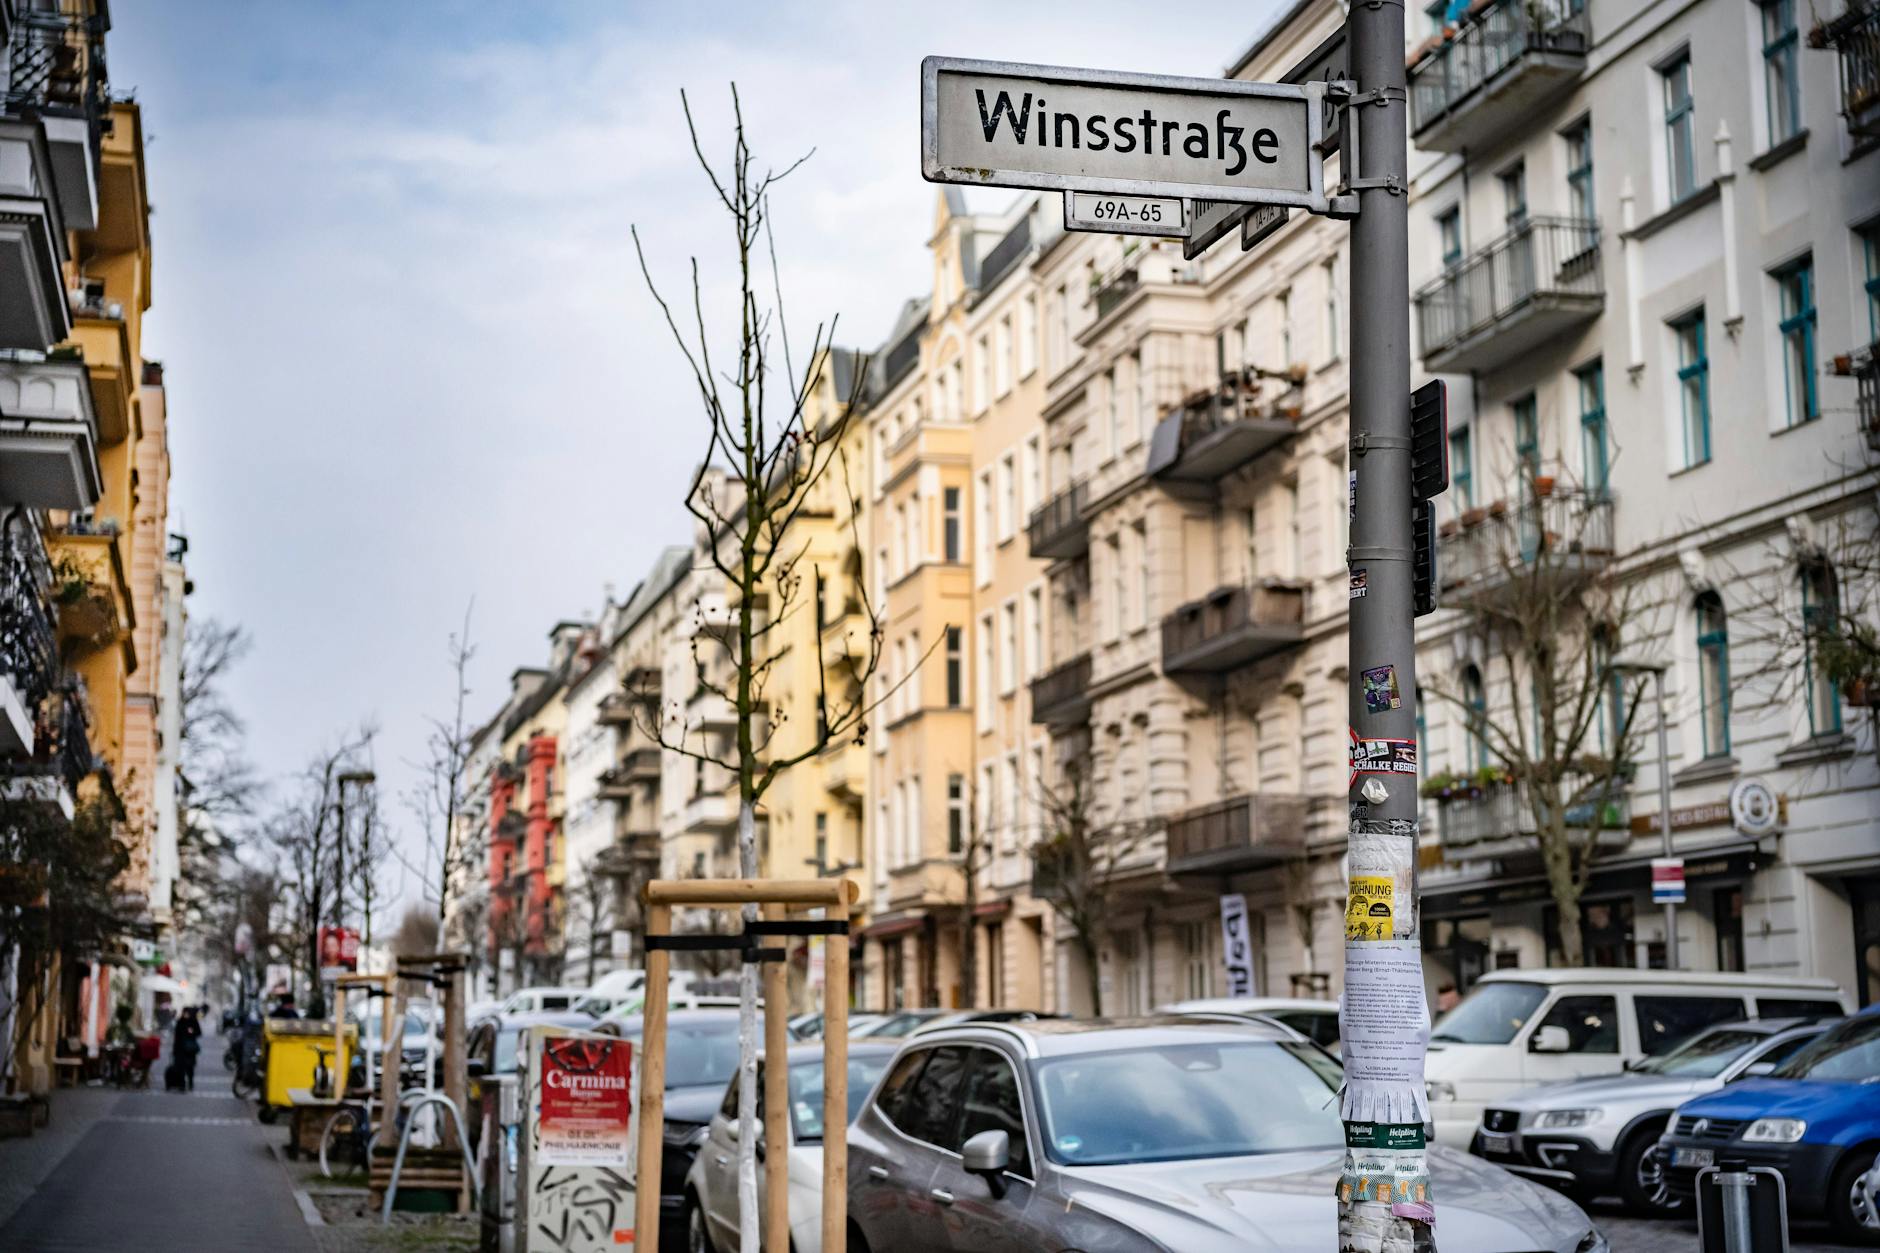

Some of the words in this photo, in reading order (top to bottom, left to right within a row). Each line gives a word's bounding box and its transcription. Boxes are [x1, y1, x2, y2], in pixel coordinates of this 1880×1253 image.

[975, 88, 1280, 176] Winsstraße
[1094, 200, 1162, 222] 69A-65
[1354, 760, 1392, 771] SCHALKE
[1350, 885, 1392, 896] WOHNUNG
[546, 1068, 626, 1089] Carmina
[1389, 1127, 1417, 1138] Helpling
[1357, 1162, 1386, 1173] Helpling
